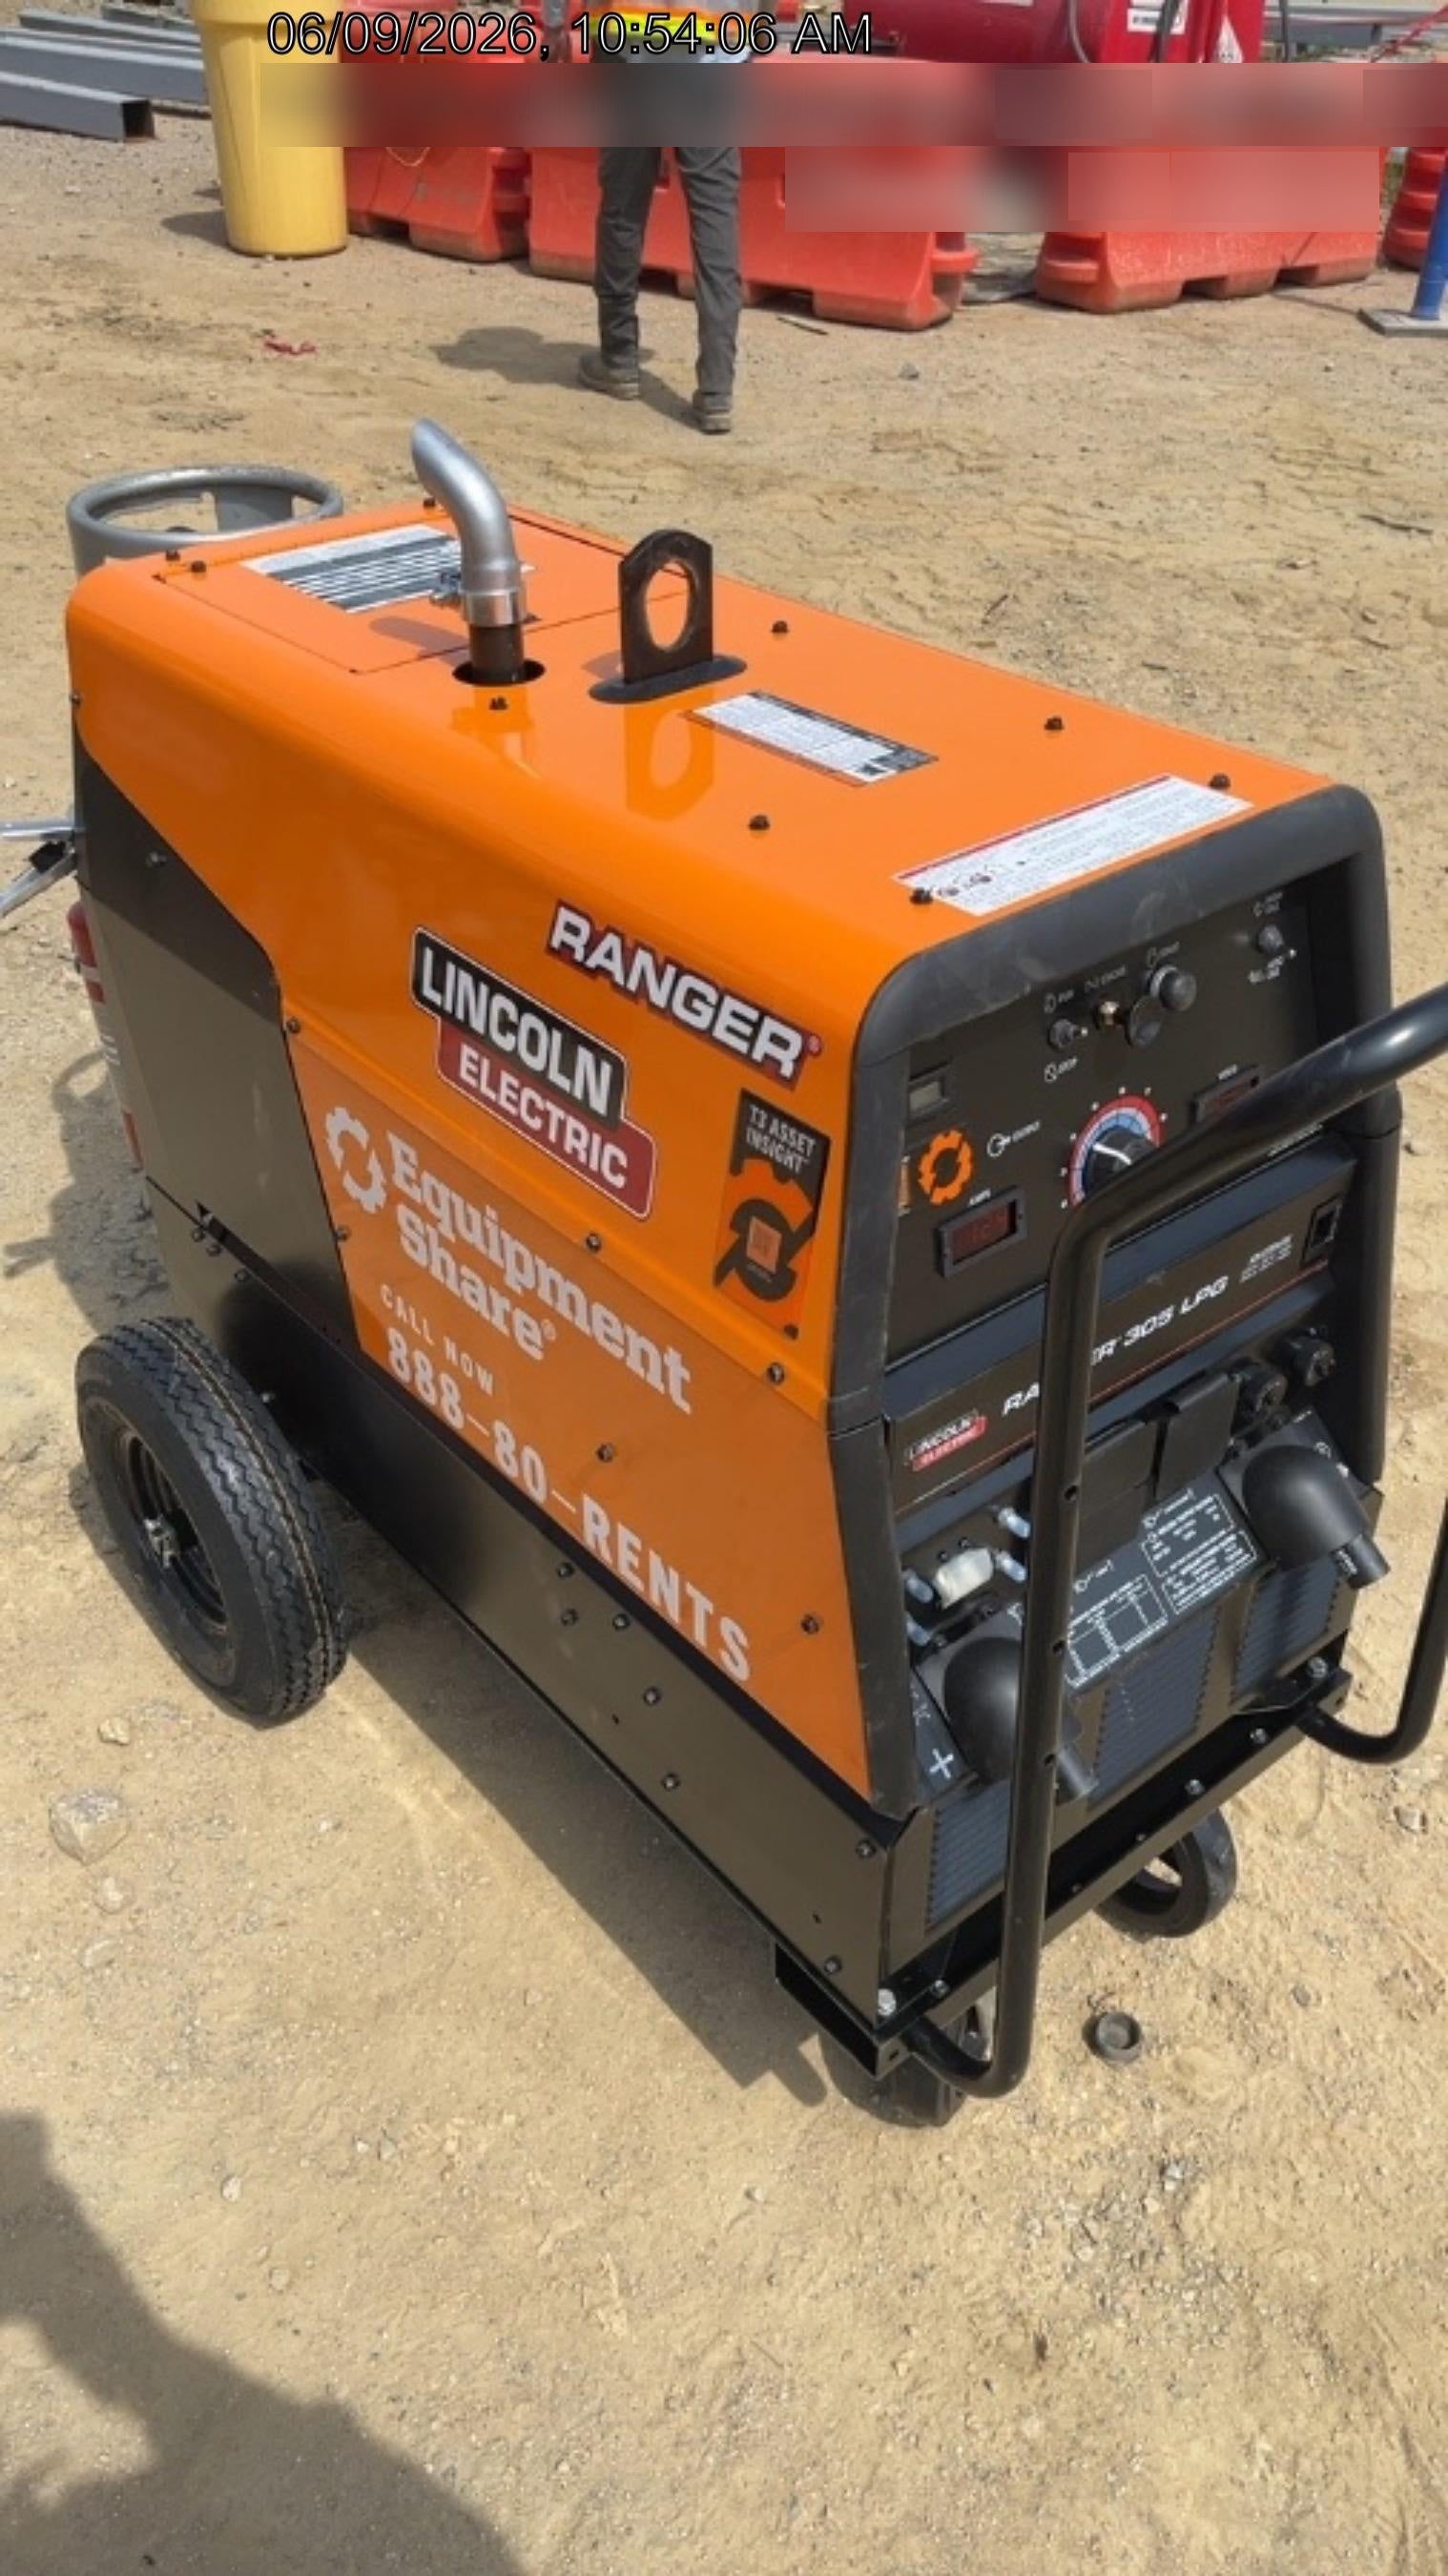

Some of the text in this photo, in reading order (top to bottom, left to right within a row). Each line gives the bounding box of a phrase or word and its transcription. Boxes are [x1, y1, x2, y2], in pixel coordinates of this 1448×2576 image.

[422, 946, 612, 1117] LINCOLN
[459, 1044, 629, 1189] ELECTRIC
[769, 1118, 817, 1157] ASSET
[386, 1131, 693, 1414] Equipment
[1124, 1305, 1175, 1346] 305
[1179, 1276, 1230, 1314] LPG
[381, 1284, 495, 1396] CALL NOW
